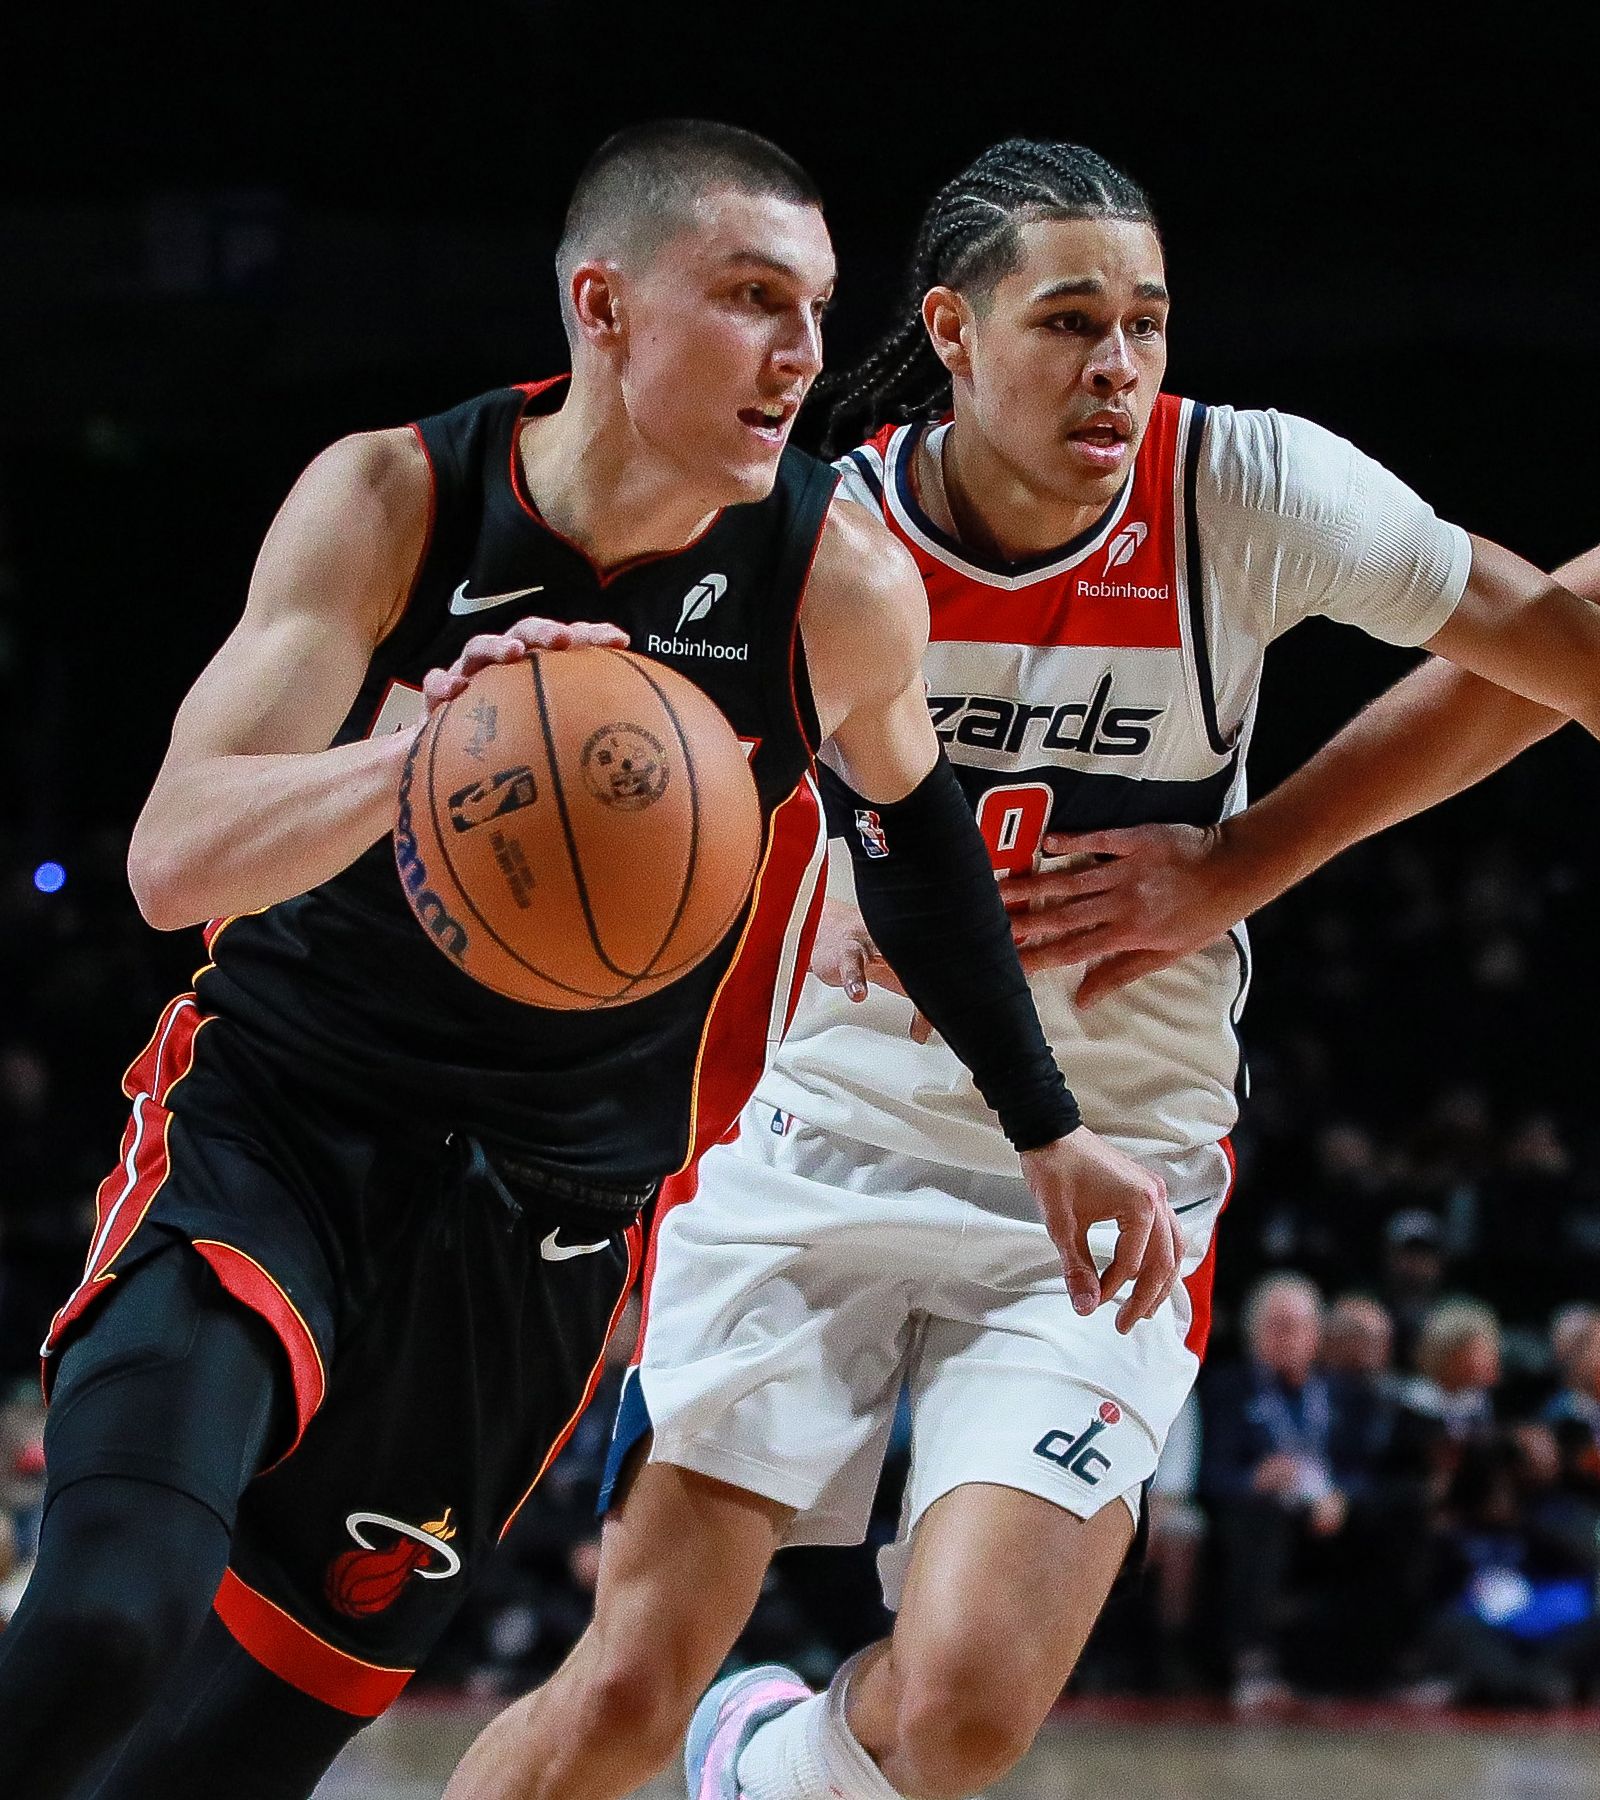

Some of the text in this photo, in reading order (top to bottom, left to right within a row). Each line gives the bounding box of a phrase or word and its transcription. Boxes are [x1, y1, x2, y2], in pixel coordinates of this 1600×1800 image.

[1077, 580, 1169, 600] Robinhood
[647, 634, 748, 661] Robinhood
[1032, 1418, 1112, 1486] dc
